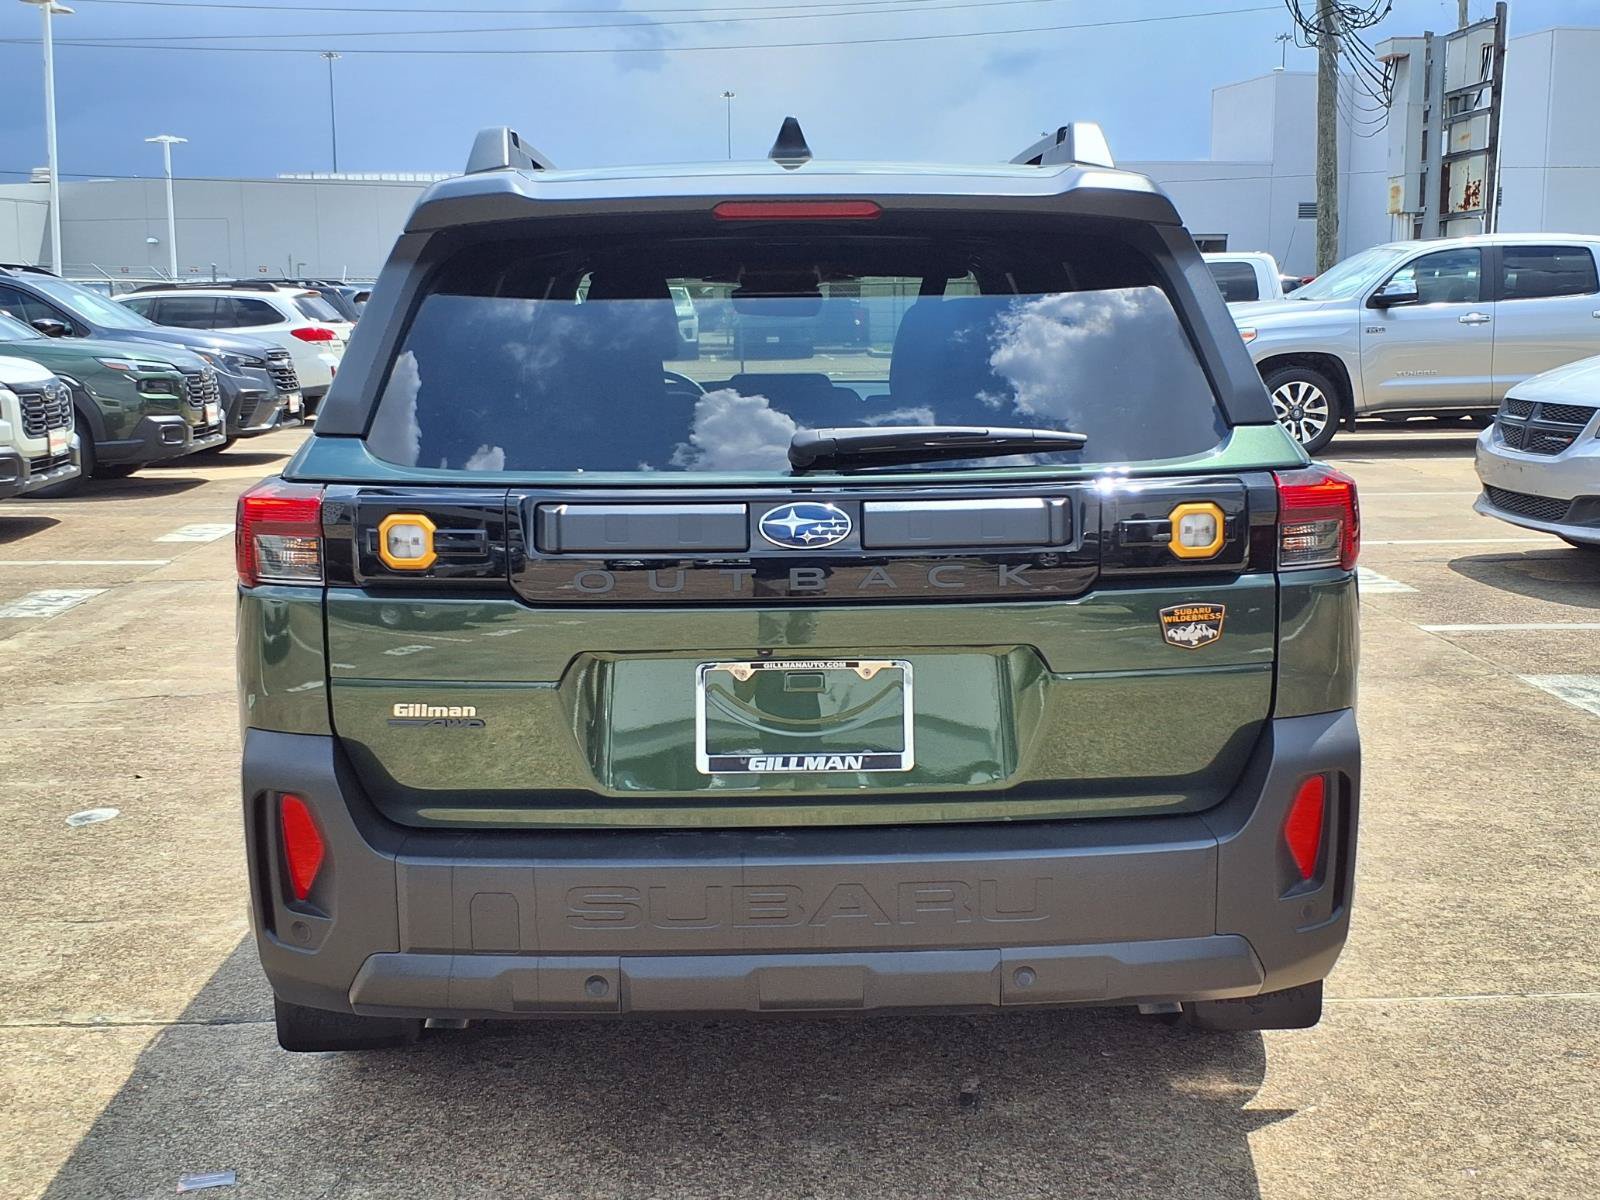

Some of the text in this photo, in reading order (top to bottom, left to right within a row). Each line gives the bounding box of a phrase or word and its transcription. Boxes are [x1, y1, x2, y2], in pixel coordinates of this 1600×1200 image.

[573, 563, 1034, 593] OUTBACK
[1163, 612, 1222, 623] WILDERNESS
[1173, 607, 1212, 616] SUBARU
[763, 661, 847, 669] GILLMANAUTO.COM
[393, 703, 477, 717] Gillman
[425, 719, 486, 728] AWD
[748, 755, 864, 771] GILLMAN
[566, 877, 1053, 931] SUBARU
